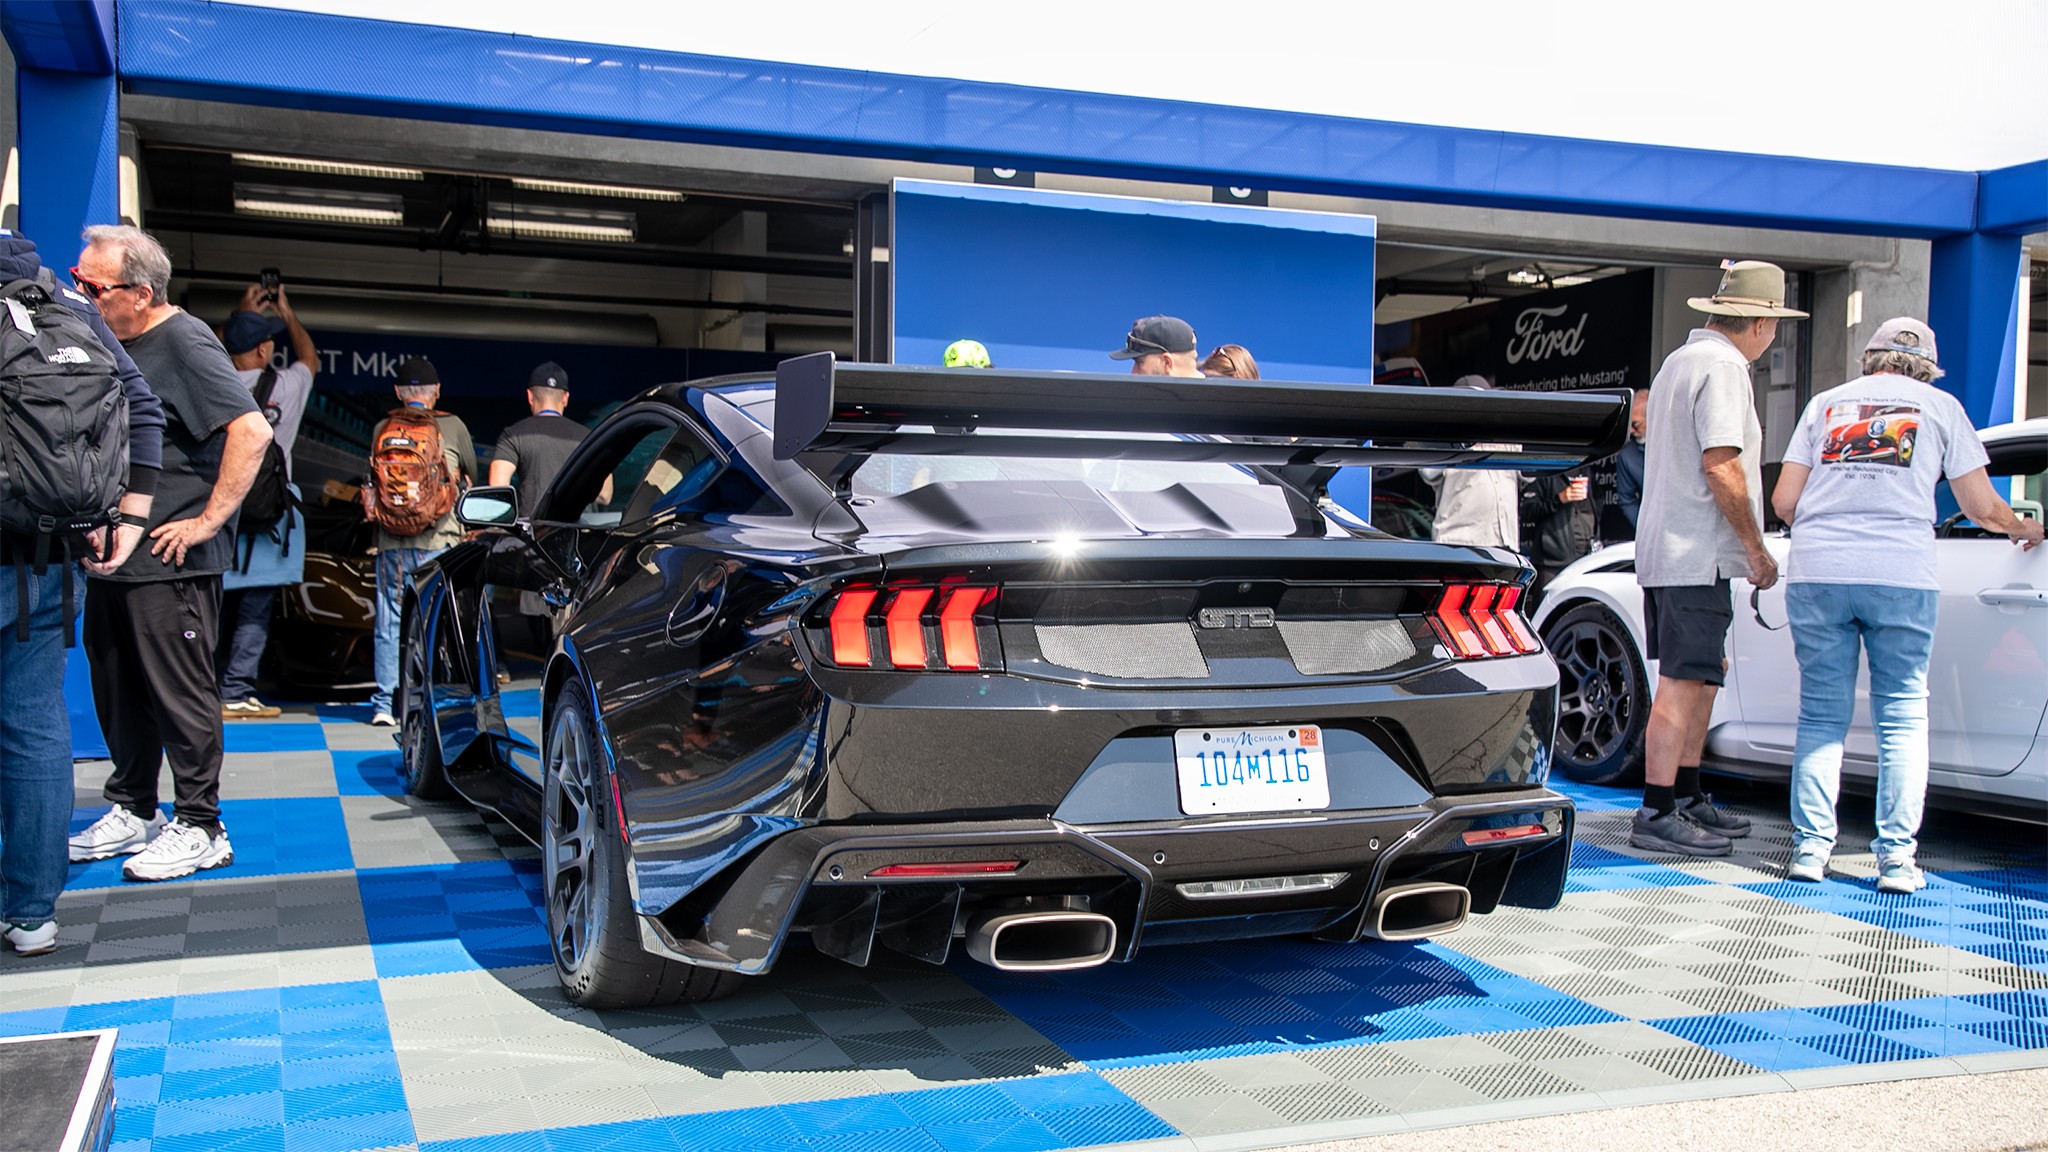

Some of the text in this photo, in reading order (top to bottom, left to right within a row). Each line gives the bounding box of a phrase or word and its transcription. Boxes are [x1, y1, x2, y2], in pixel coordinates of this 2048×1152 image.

[1506, 304, 1588, 365] Ford
[1561, 376, 1577, 389] the
[1199, 607, 1275, 628] GTD
[1216, 731, 1284, 749] PURE MICHIGAN
[1304, 731, 1316, 740] 28
[1196, 747, 1310, 787] 104M116
